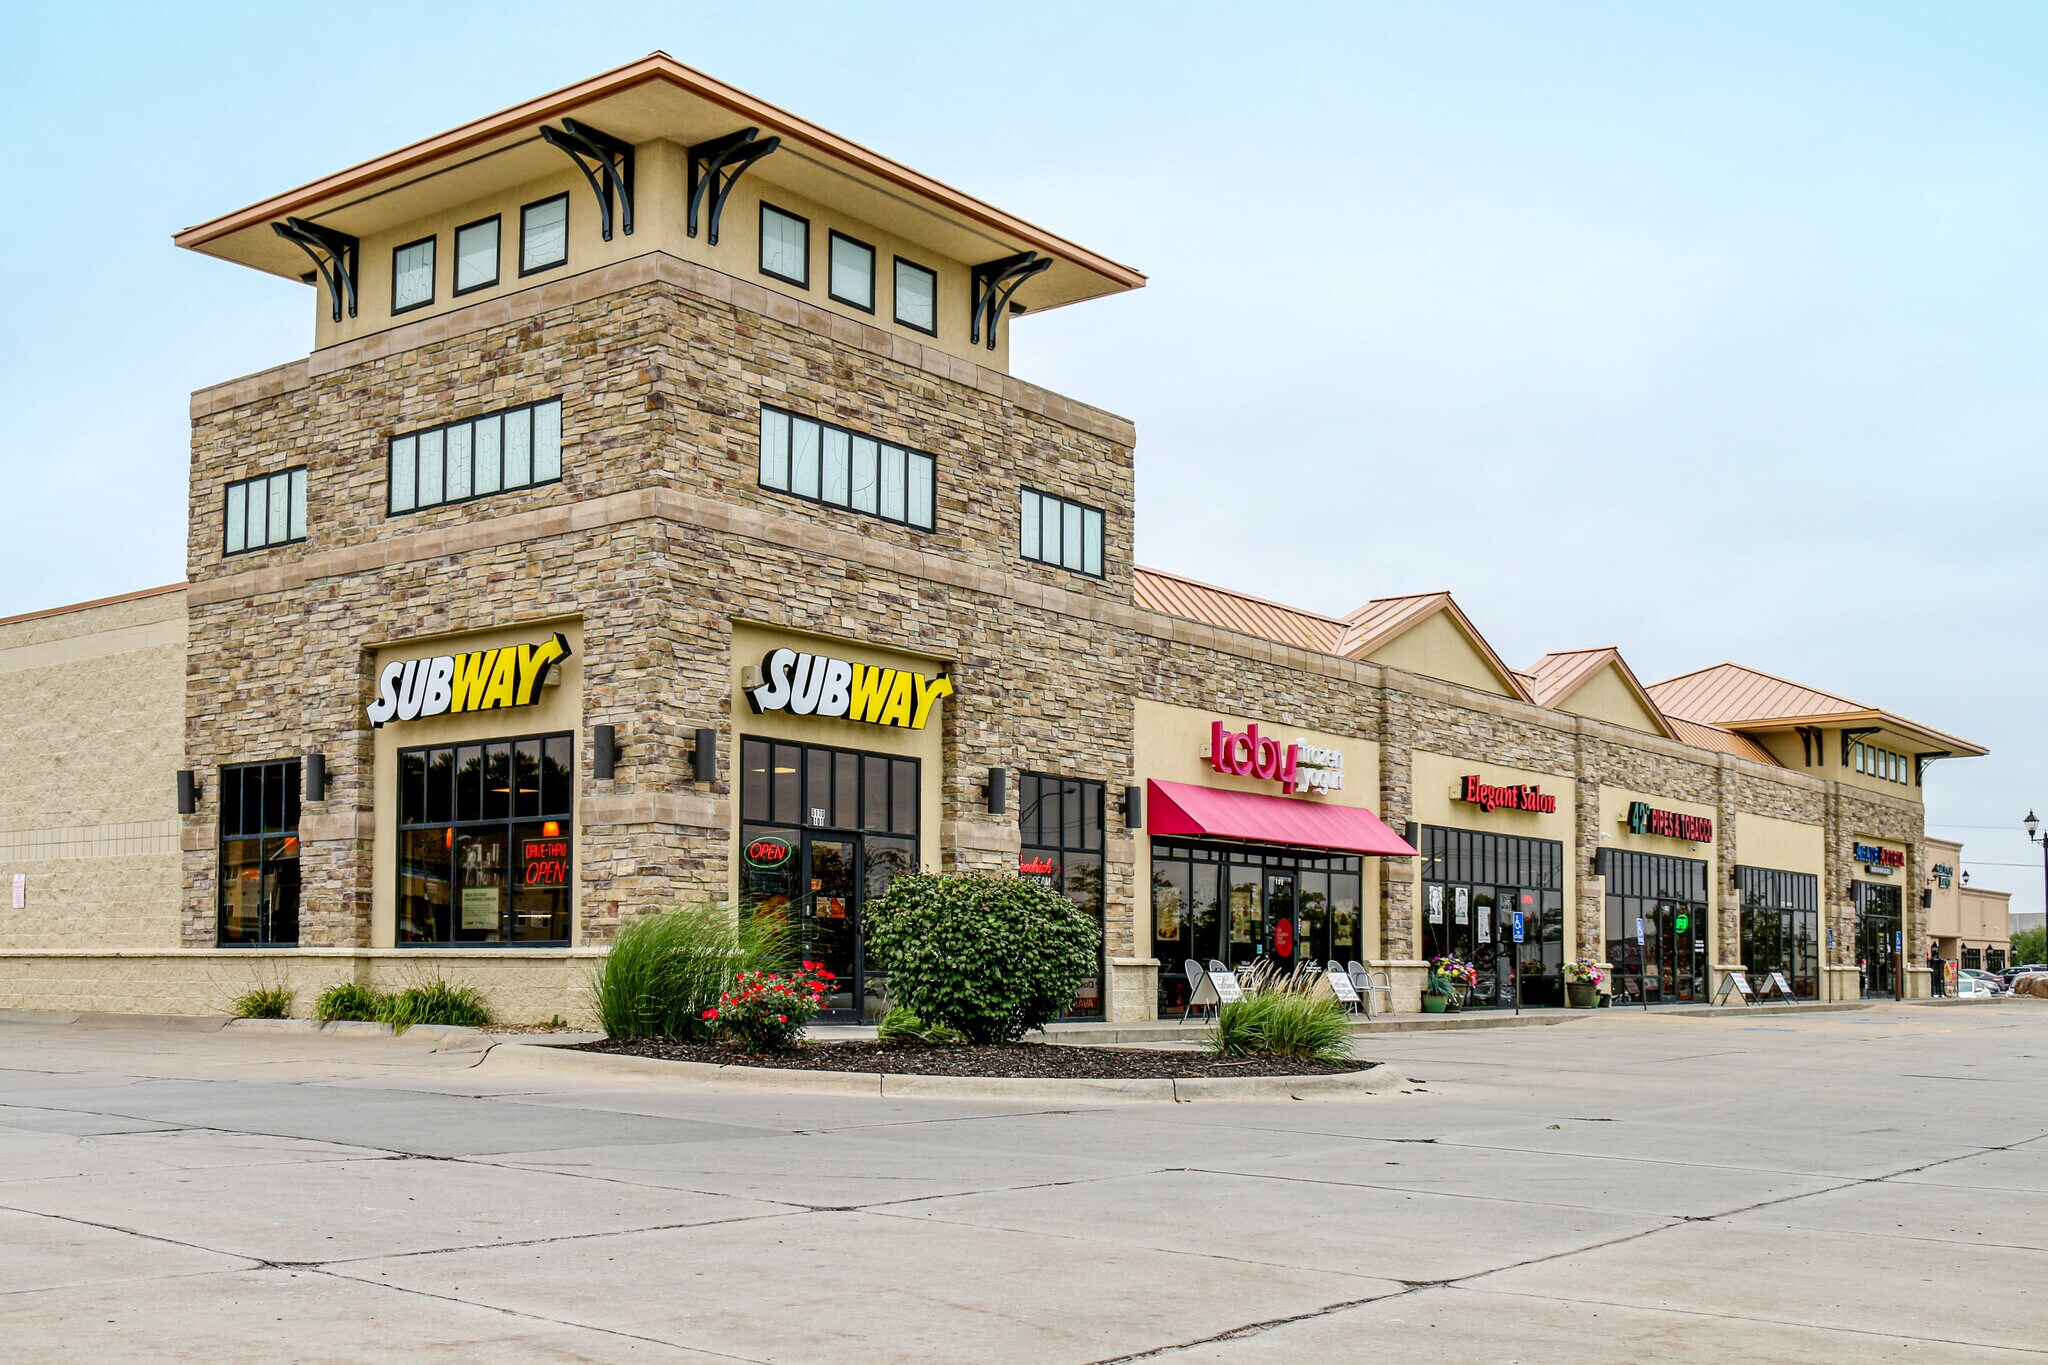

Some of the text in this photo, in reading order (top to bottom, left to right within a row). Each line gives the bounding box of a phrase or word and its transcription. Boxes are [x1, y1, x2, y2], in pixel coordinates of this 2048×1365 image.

[366, 632, 571, 728] SUBWAY
[746, 648, 953, 730] SUBWAY
[1212, 721, 1298, 794] tcby
[1296, 737, 1343, 768] frozen
[1463, 775, 1556, 813] Elegant Salon
[1652, 809, 1674, 837] PIPES
[1681, 815, 1712, 842] TOBACCO
[525, 843, 567, 859] DRIVE-THRU
[749, 842, 787, 860] OPEN
[526, 861, 567, 885] OPEN
